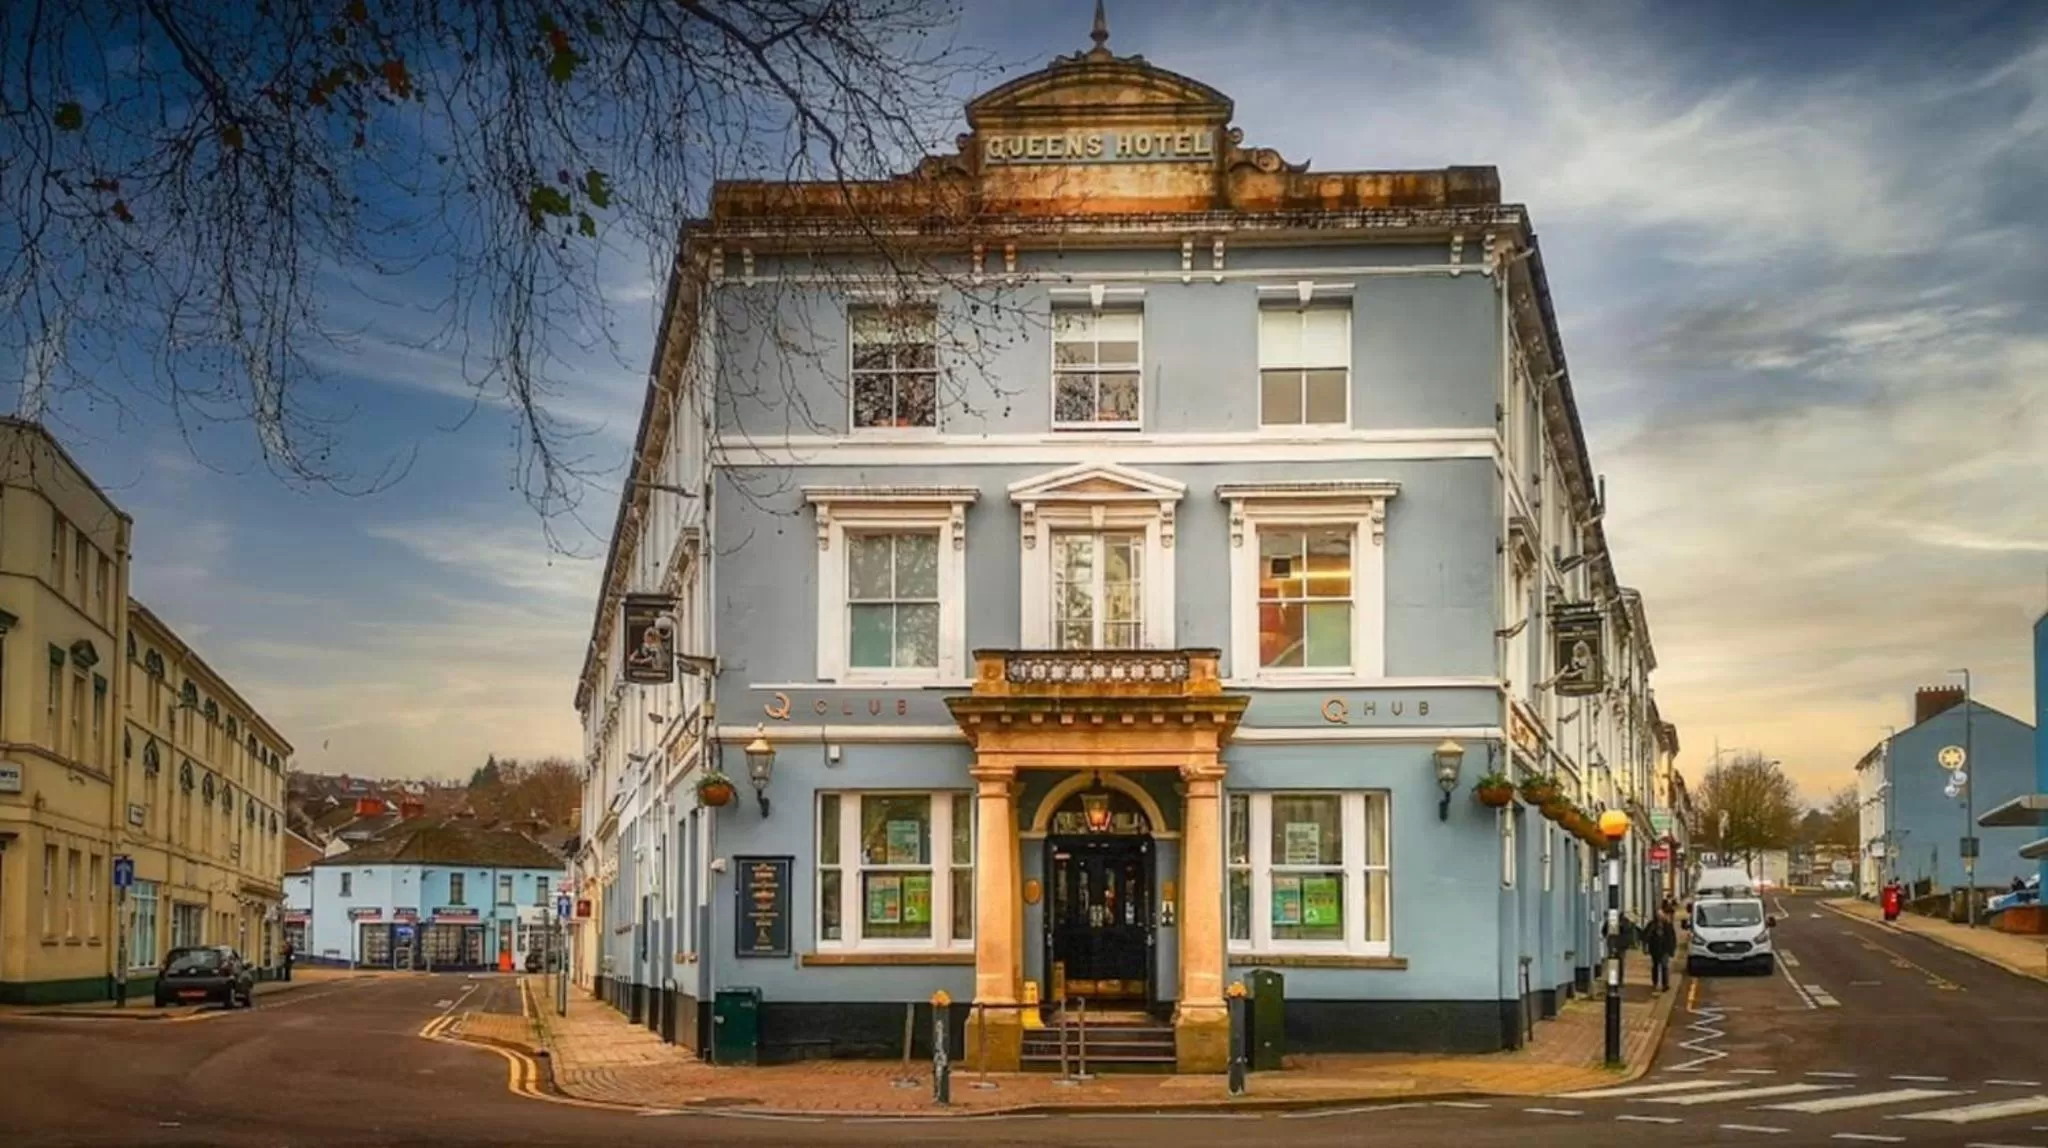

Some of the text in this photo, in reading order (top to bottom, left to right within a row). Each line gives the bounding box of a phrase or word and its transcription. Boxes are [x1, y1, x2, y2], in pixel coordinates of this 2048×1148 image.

[986, 131, 1212, 160] QUEENS HOTEL
[764, 691, 907, 721] Q CLUB
[1321, 697, 1429, 725] Q HUB
